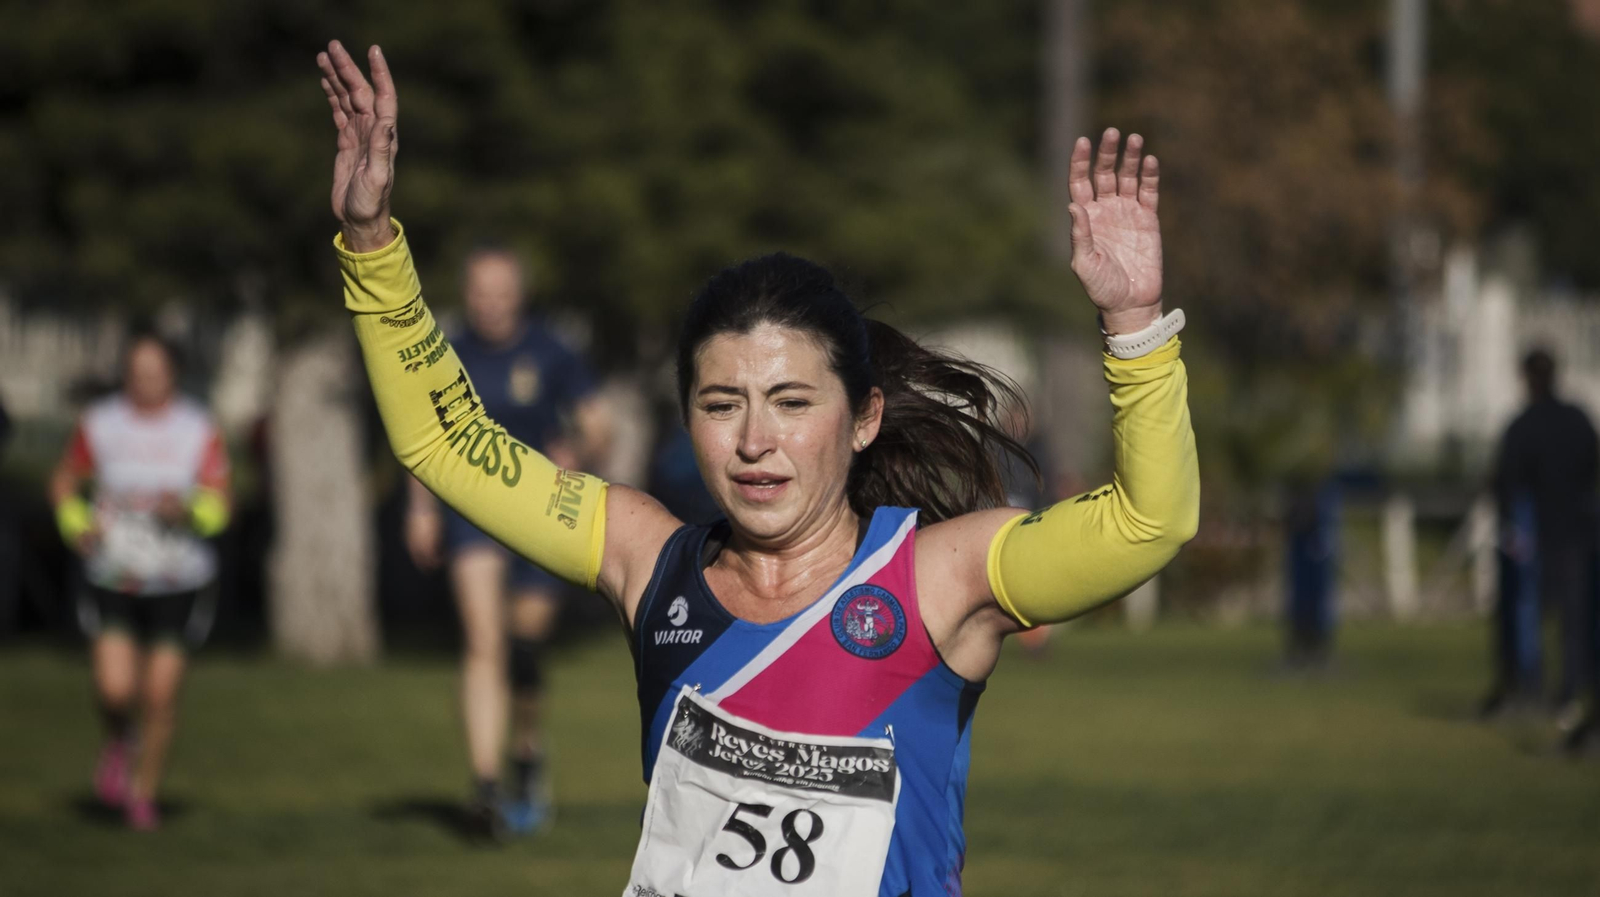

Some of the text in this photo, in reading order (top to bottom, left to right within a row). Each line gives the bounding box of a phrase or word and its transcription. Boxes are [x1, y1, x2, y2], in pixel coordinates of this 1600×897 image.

[841, 586, 875, 605] ATLETISMO
[876, 589, 903, 619] CARMONA
[834, 606, 843, 617] DE
[654, 629, 704, 646] VIATOR
[833, 618, 844, 639] CLUB
[858, 642, 897, 657] FERNANDO
[709, 721, 890, 775] Reyes Magos
[758, 734, 828, 753] CARRERA
[708, 747, 835, 783] Jerez 2025
[715, 803, 825, 885] 58
